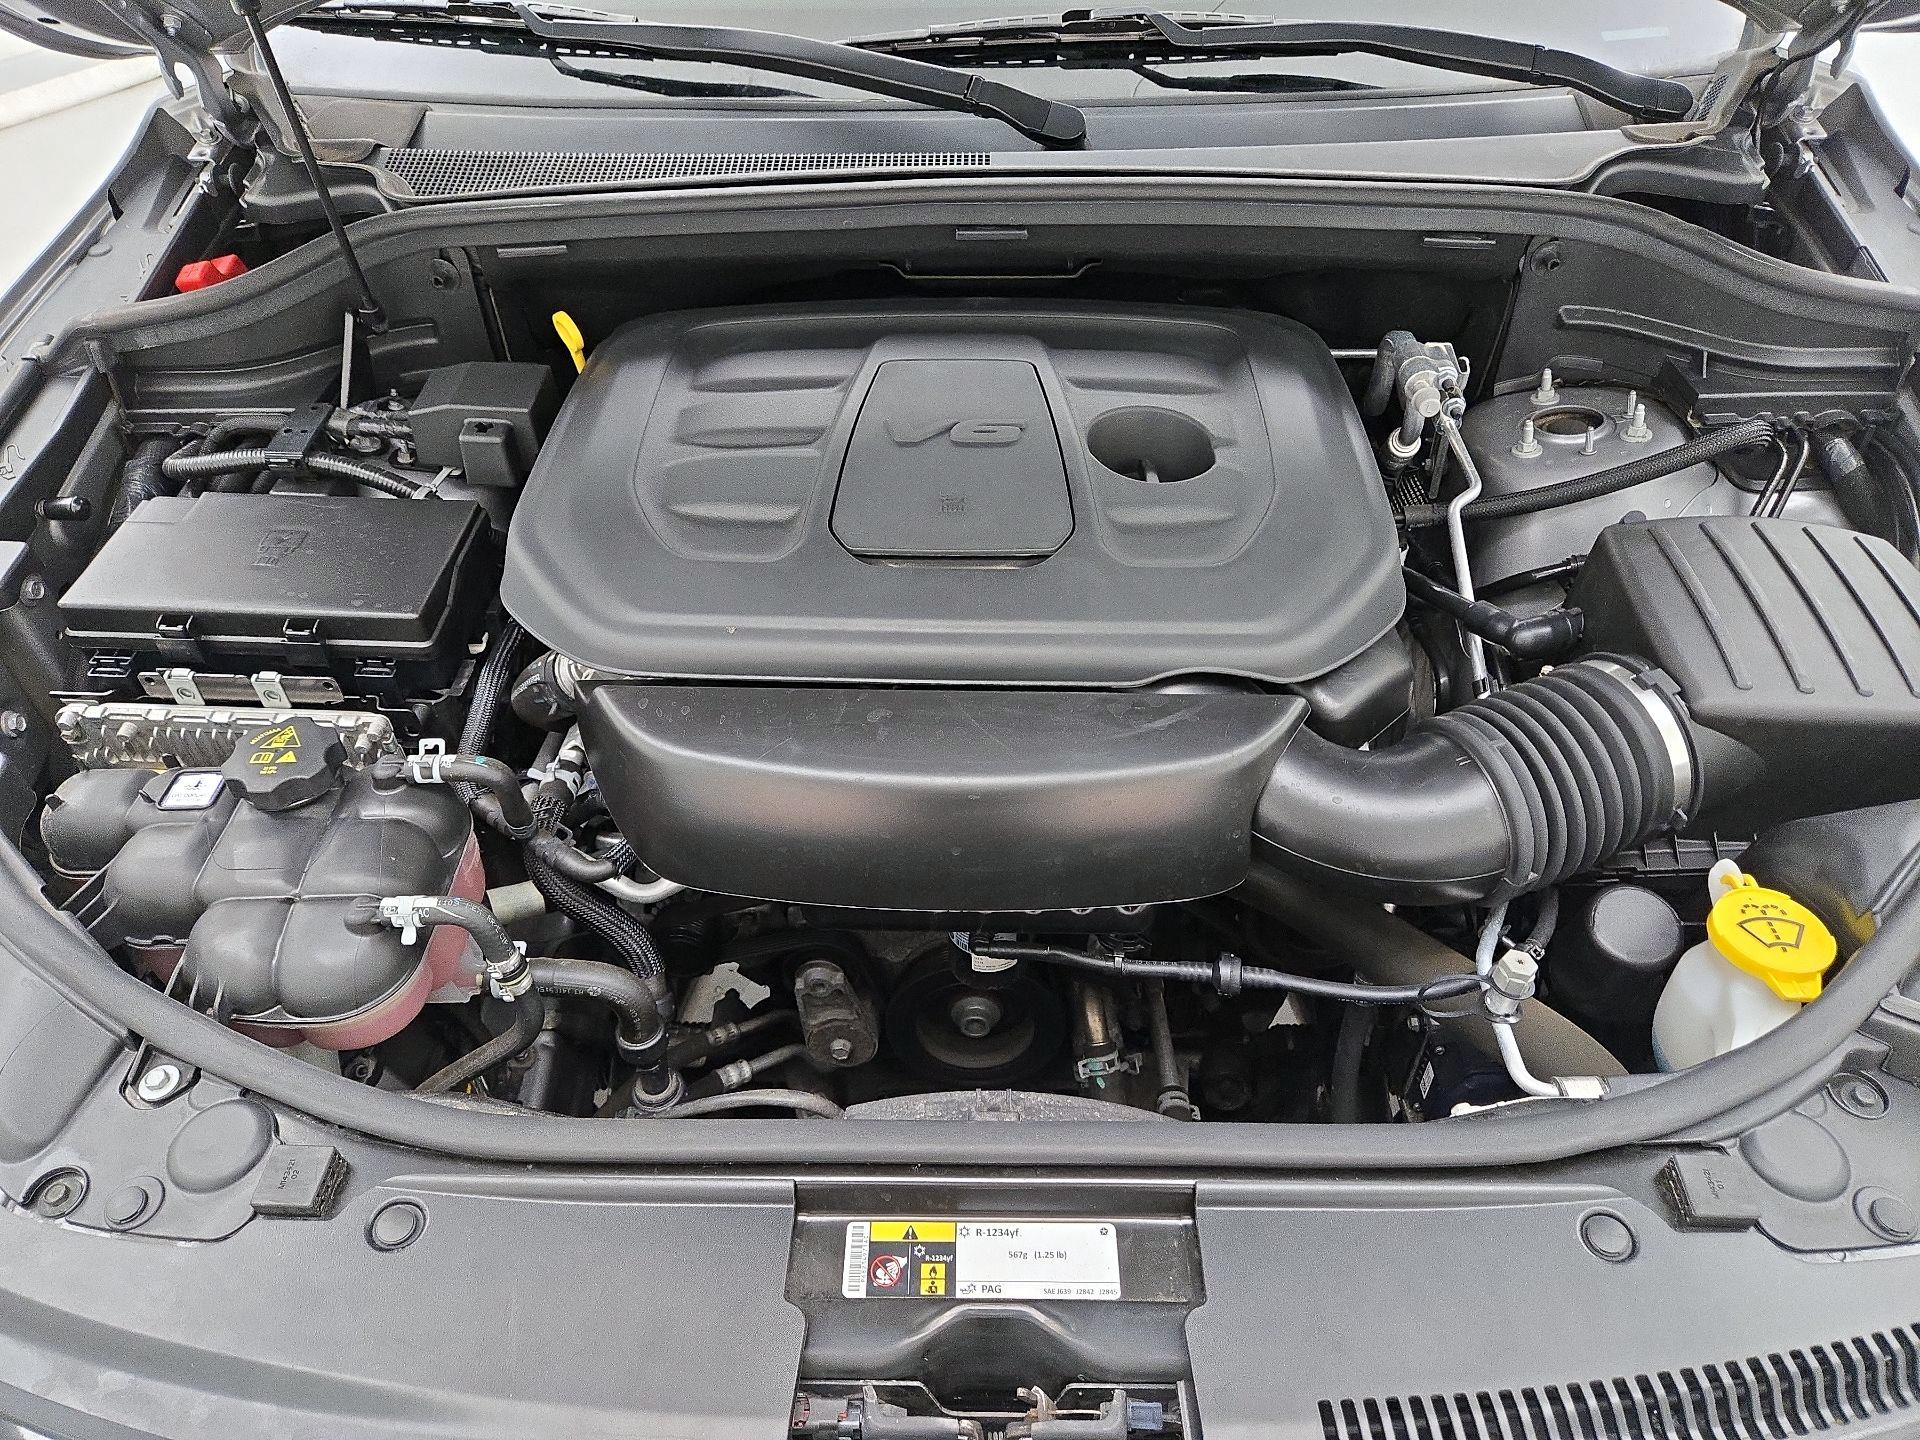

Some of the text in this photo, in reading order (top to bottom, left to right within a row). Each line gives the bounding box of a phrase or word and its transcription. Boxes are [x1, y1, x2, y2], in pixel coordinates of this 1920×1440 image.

[883, 418, 1026, 449] V6
[1008, 1250, 1068, 1260] 567g (1.25 lb)
[981, 1284, 1003, 1294] PAG
